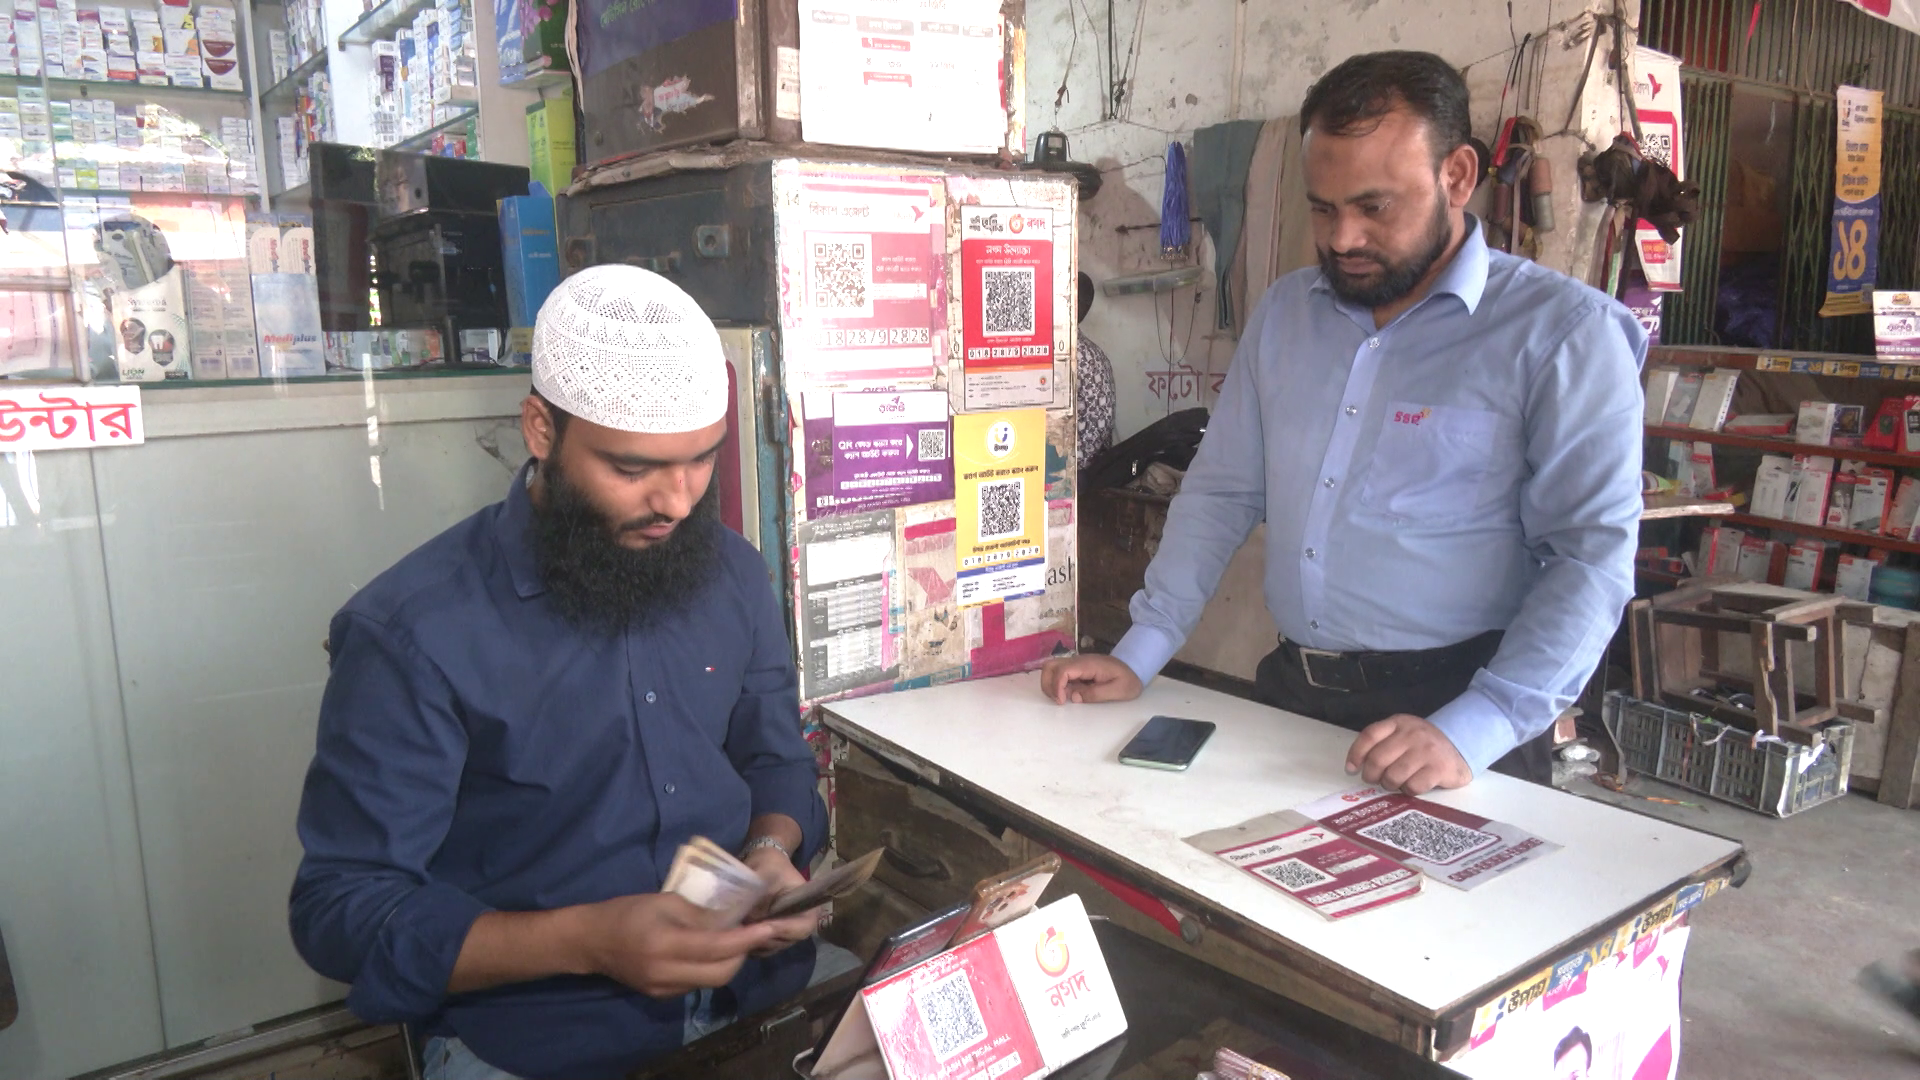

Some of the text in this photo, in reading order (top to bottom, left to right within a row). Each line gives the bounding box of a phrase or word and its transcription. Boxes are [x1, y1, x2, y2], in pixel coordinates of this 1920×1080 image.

[809, 201, 870, 218] বিকাশ এজেন্ট
[1027, 217, 1046, 230] নগদ
[263, 333, 317, 345] Mediplus
[891, 329, 929, 344] 2828
[968, 345, 1048, 359] 018 2879 2828
[122, 369, 144, 377] LION
[1146, 362, 1202, 402] ফটো
[1045, 556, 1075, 586] ash
[1045, 969, 1091, 1008] নগদ
[1507, 977, 1548, 1014] উপায়
[992, 1033, 1012, 1051] HALL
